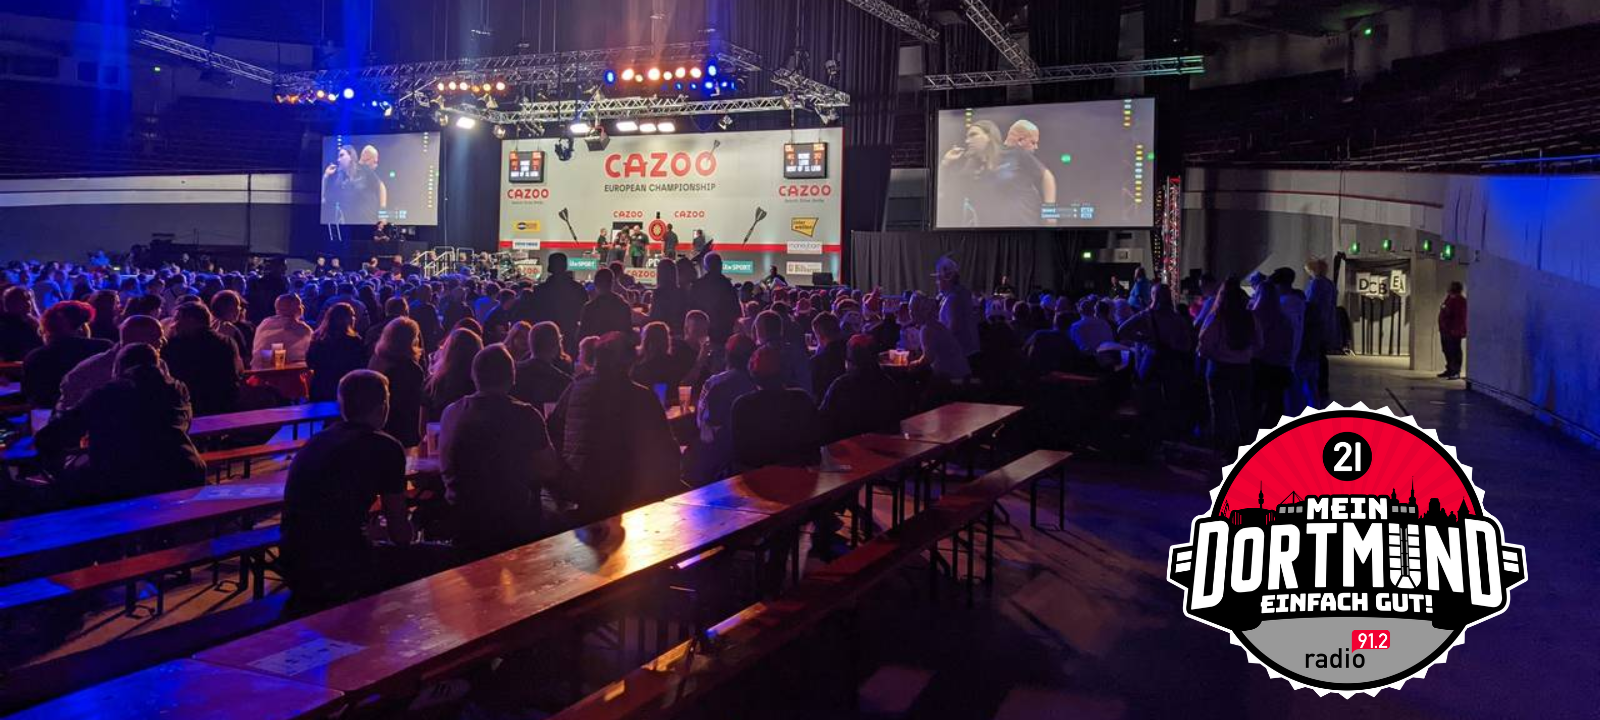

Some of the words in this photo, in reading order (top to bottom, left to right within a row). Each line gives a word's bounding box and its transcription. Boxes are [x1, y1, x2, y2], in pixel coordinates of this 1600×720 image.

[605, 152, 717, 178] CAZOO
[604, 184, 647, 192] EUROPEAN
[648, 183, 717, 192] CHAMPIONSHIP
[779, 184, 831, 197] CAZOO
[507, 188, 549, 199] CAZOO
[613, 210, 643, 218] CAZOO
[674, 210, 705, 218] CAZOO
